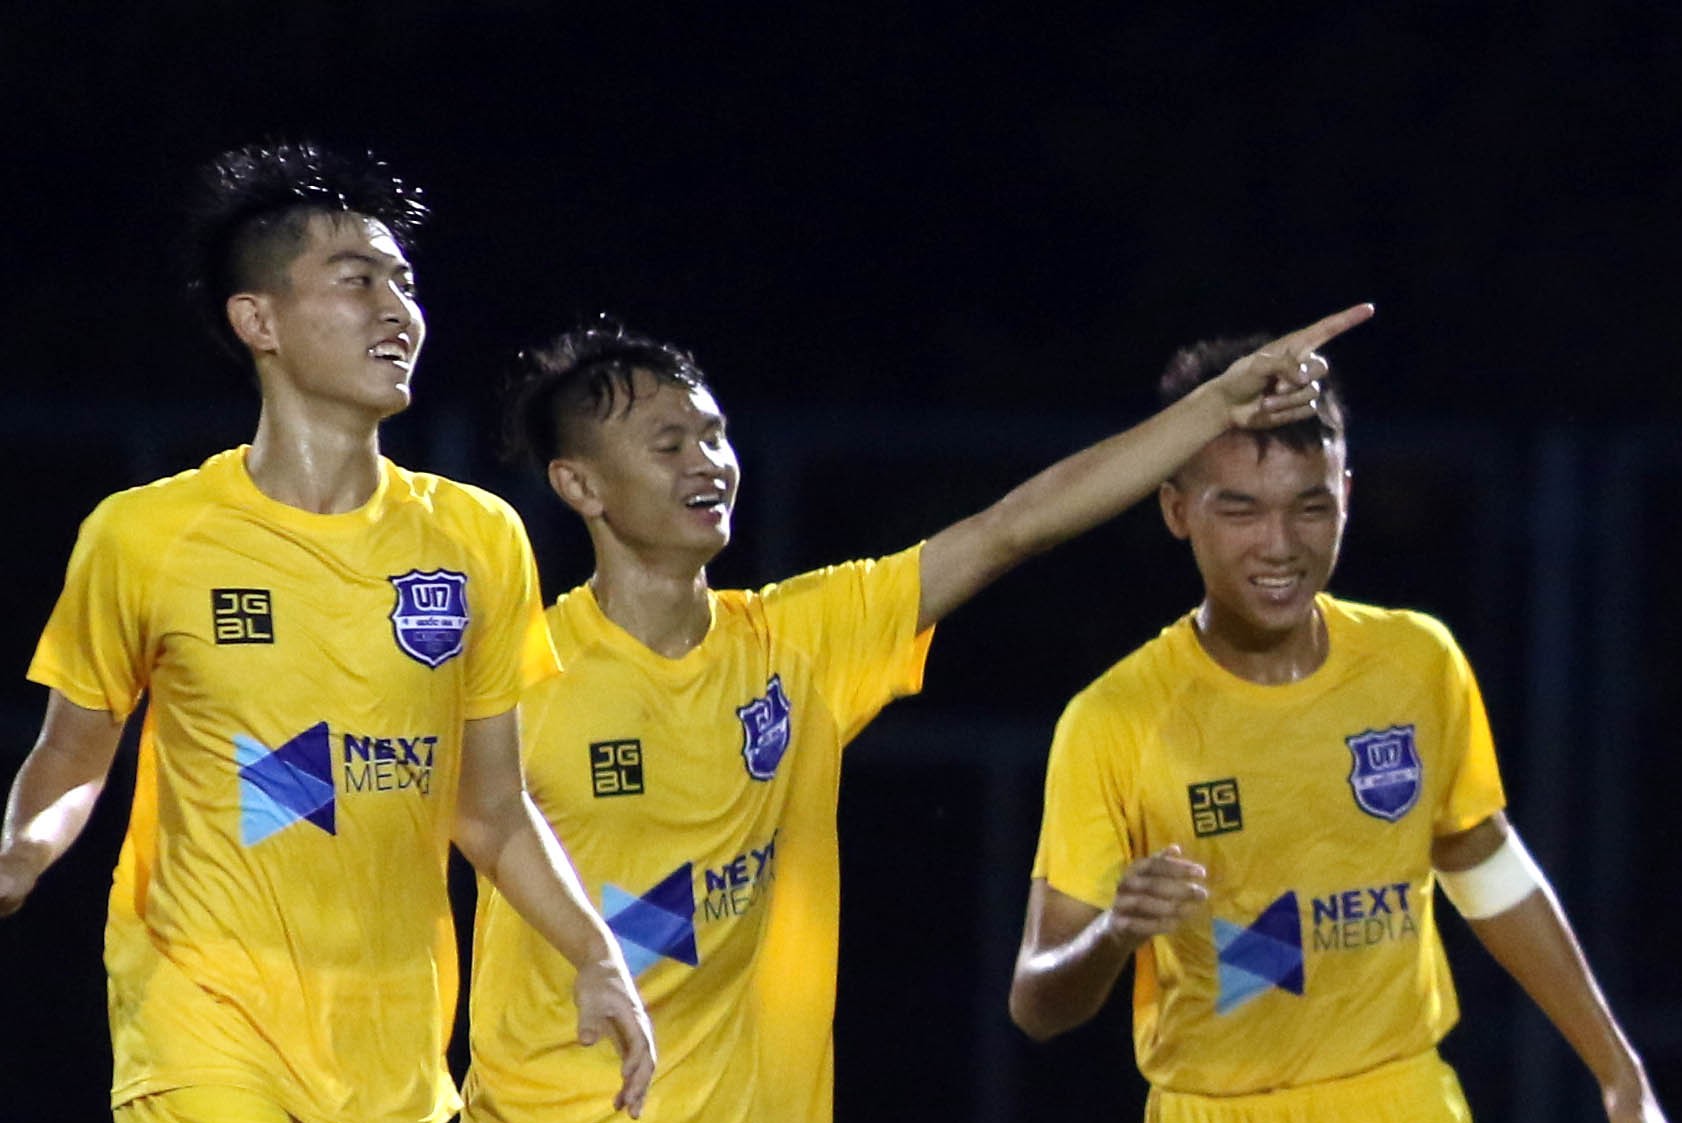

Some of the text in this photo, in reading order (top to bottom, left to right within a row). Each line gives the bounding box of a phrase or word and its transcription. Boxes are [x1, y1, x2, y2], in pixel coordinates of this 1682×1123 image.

[344, 733, 438, 767] NEXT
[345, 763, 430, 795] MEDA
[1312, 882, 1410, 926] NEXT
[1312, 912, 1420, 952] MEDIA
